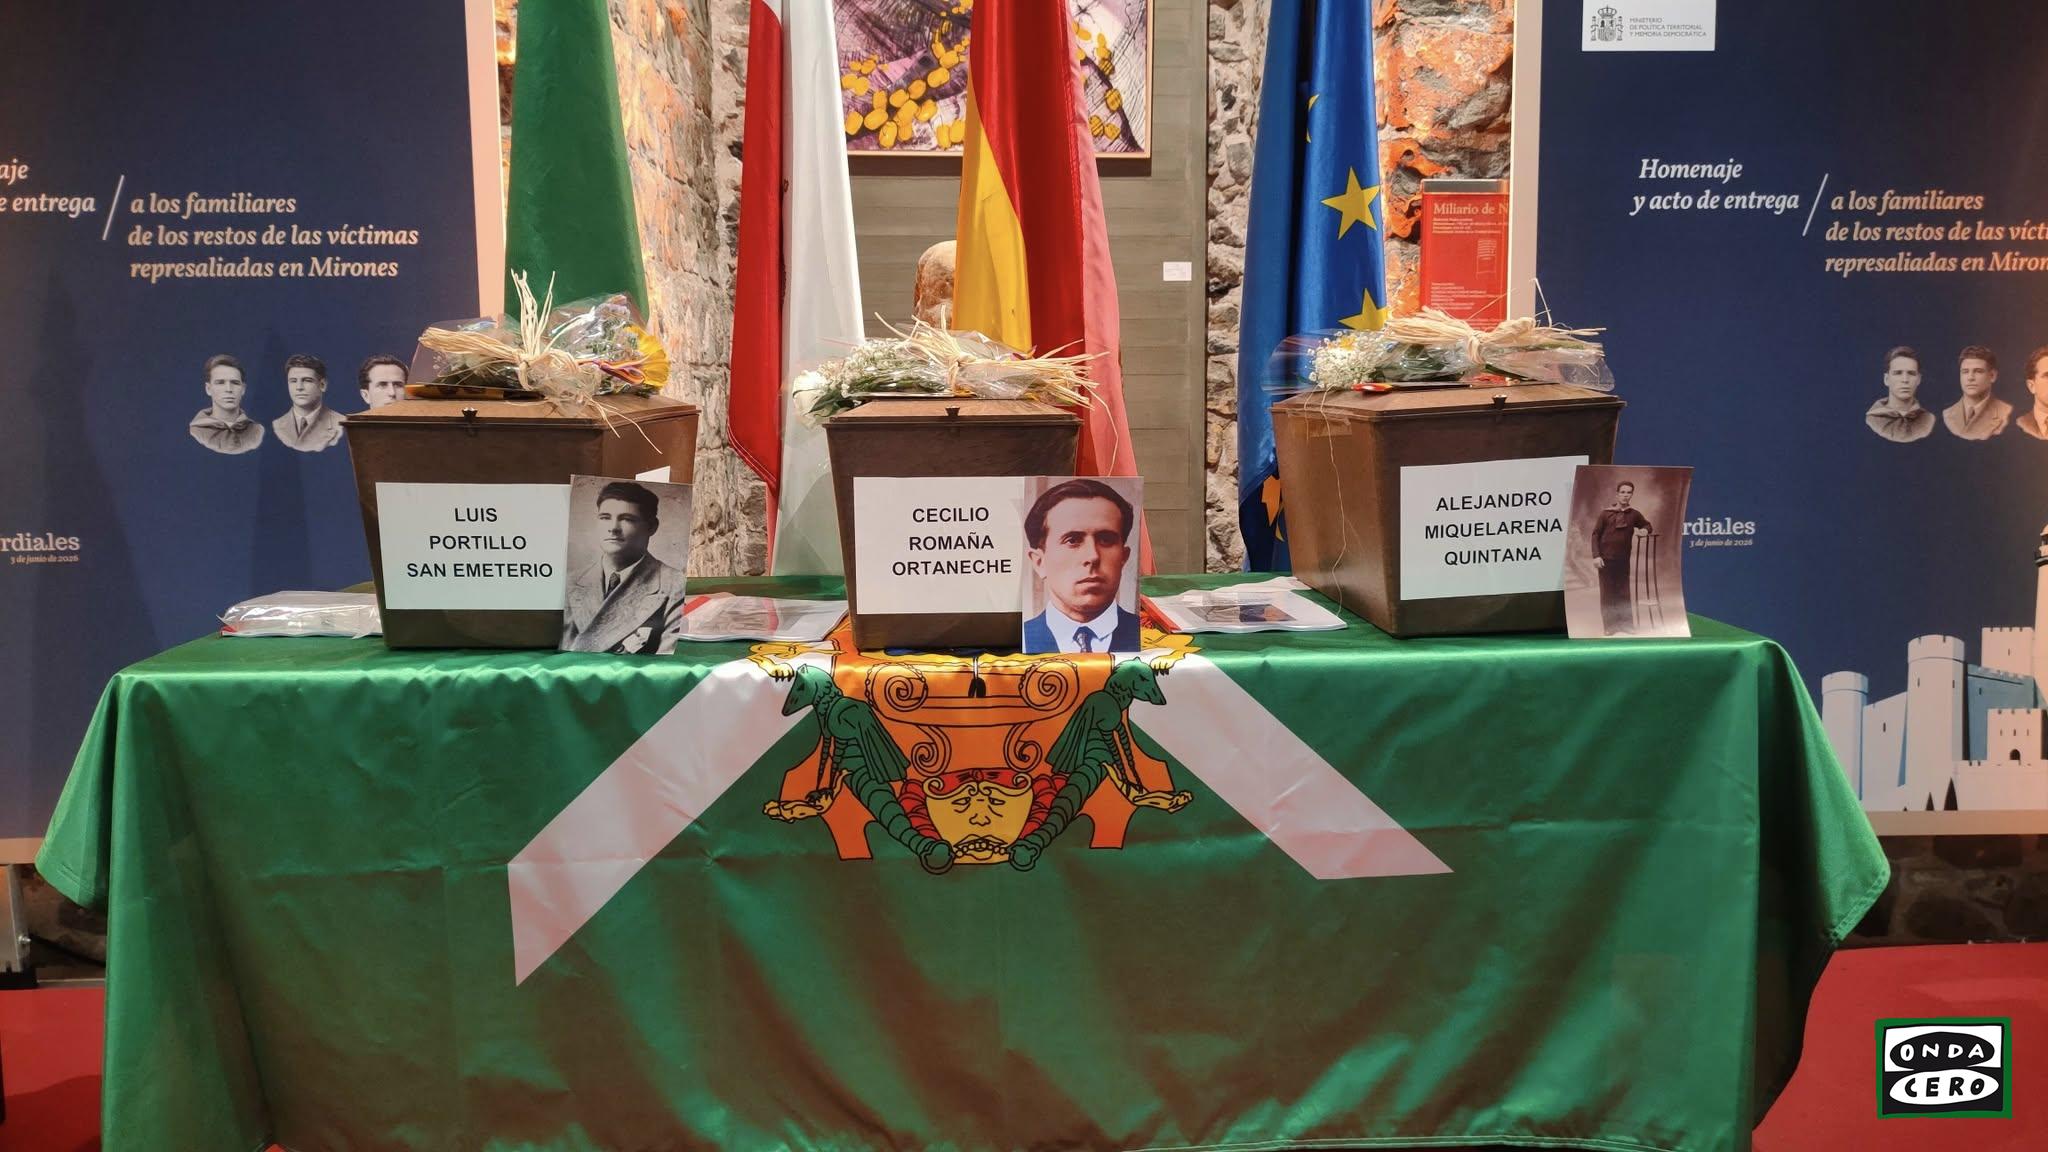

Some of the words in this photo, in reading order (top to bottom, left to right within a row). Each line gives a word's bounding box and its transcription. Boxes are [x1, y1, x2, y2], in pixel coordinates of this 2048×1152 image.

[1639, 158, 1743, 184] Homenaje
[12, 193, 96, 219] entrega
[131, 198, 144, 214] a
[150, 193, 181, 214] los
[183, 192, 297, 220] familiares
[1433, 202, 1479, 215] Miliario
[1481, 202, 1495, 215] de
[1629, 194, 1647, 216] y
[1649, 192, 1693, 210] acto
[1696, 189, 1720, 210] de
[1723, 191, 1799, 215] entrega
[1831, 196, 1845, 211] a
[1848, 190, 1877, 211] los
[1878, 190, 1984, 217] familiares
[128, 225, 152, 246] de
[158, 225, 188, 246] los
[193, 229, 257, 246] restos
[262, 225, 286, 246] de
[291, 225, 322, 246] las
[327, 223, 419, 246] víctimas
[1825, 221, 1849, 242] de
[1853, 221, 1881, 242] los
[1885, 225, 1944, 242] restos
[1948, 221, 1971, 242] de
[1975, 221, 2004, 241] las
[130, 257, 274, 284] represaliadas
[279, 261, 304, 277] en
[309, 257, 399, 278] Mirones
[1825, 252, 1956, 278] represaliadas
[1961, 257, 1985, 272] en
[1436, 491, 1552, 512] ALEJANDRO
[454, 507, 498, 523] LUIS
[911, 506, 990, 523] CECILIO
[1424, 518, 1563, 540] MIQUELARENA
[1681, 517, 1756, 536] rdiales
[429, 534, 527, 550] PORTILLO
[908, 531, 994, 551] ROMAÑA
[1695, 538, 1704, 547] de
[1704, 539, 1723, 548] junio
[1724, 538, 1733, 546] de
[1444, 546, 1542, 567] QUINTANA
[406, 562, 447, 578] SAN
[453, 562, 553, 578] EMETERIO
[892, 559, 1013, 576] ORTANECHE
